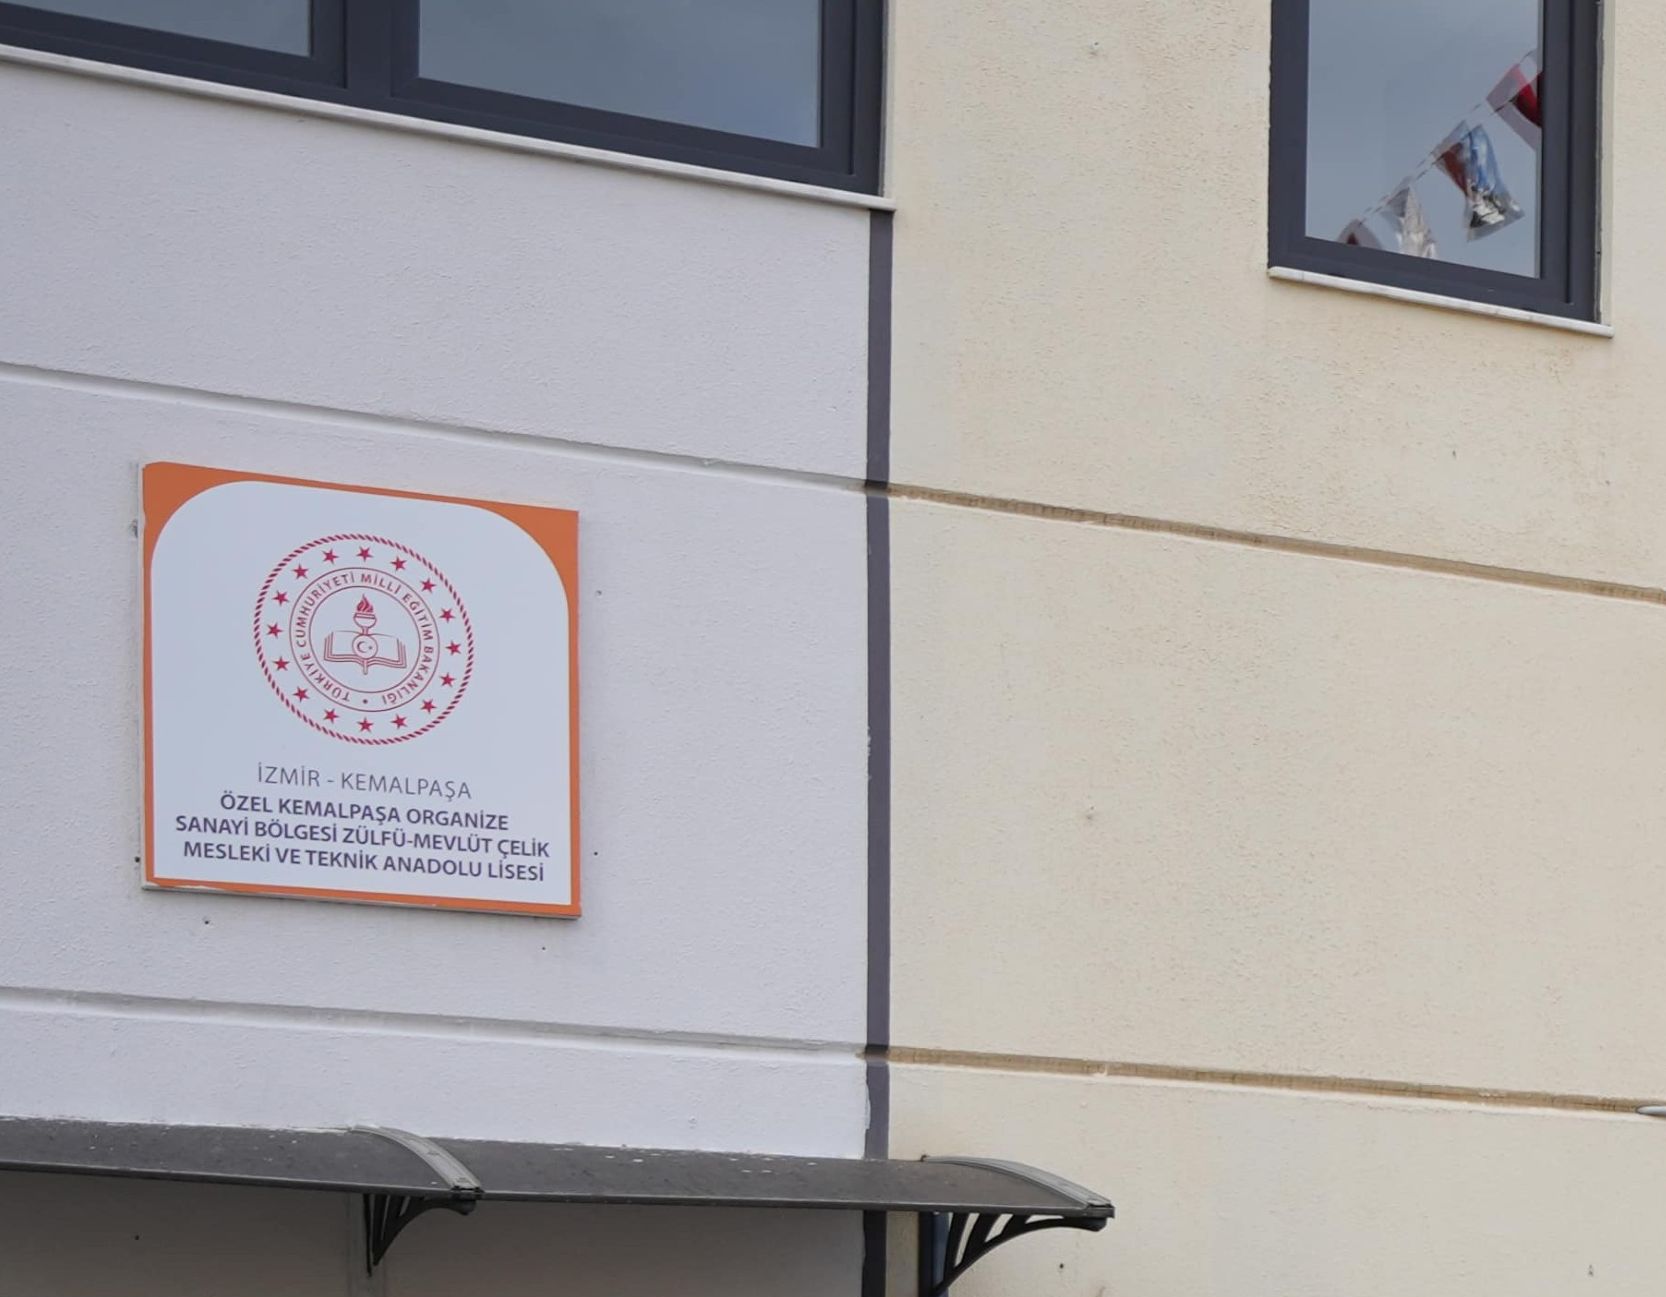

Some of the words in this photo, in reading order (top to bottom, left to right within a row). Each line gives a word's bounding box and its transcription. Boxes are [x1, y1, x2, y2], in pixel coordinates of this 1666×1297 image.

[296, 571, 355, 648] CUMHURİYETİ
[402, 593, 434, 641] EĞİTİM
[301, 653, 351, 702] TÜRKİYE
[382, 646, 434, 705] BAKANLIĞI
[257, 762, 320, 788] İZMİR
[341, 772, 472, 802] KEMALPAŞA
[220, 790, 273, 813] ÖZEL
[279, 798, 401, 826] KEMALPAŞA
[406, 808, 509, 831] ORGANİZE
[175, 815, 249, 836] SANAYİ
[254, 819, 338, 843] BÖLGESİ
[342, 825, 493, 854] ZÜLFÜ-MEVLÜT
[497, 838, 550, 859] ÇELİK
[183, 841, 270, 863] MESLEKİ
[274, 847, 301, 865] VE
[305, 849, 379, 871] TEKNİK
[382, 855, 482, 877] ANADOLU
[487, 860, 545, 882] LİSESİ
